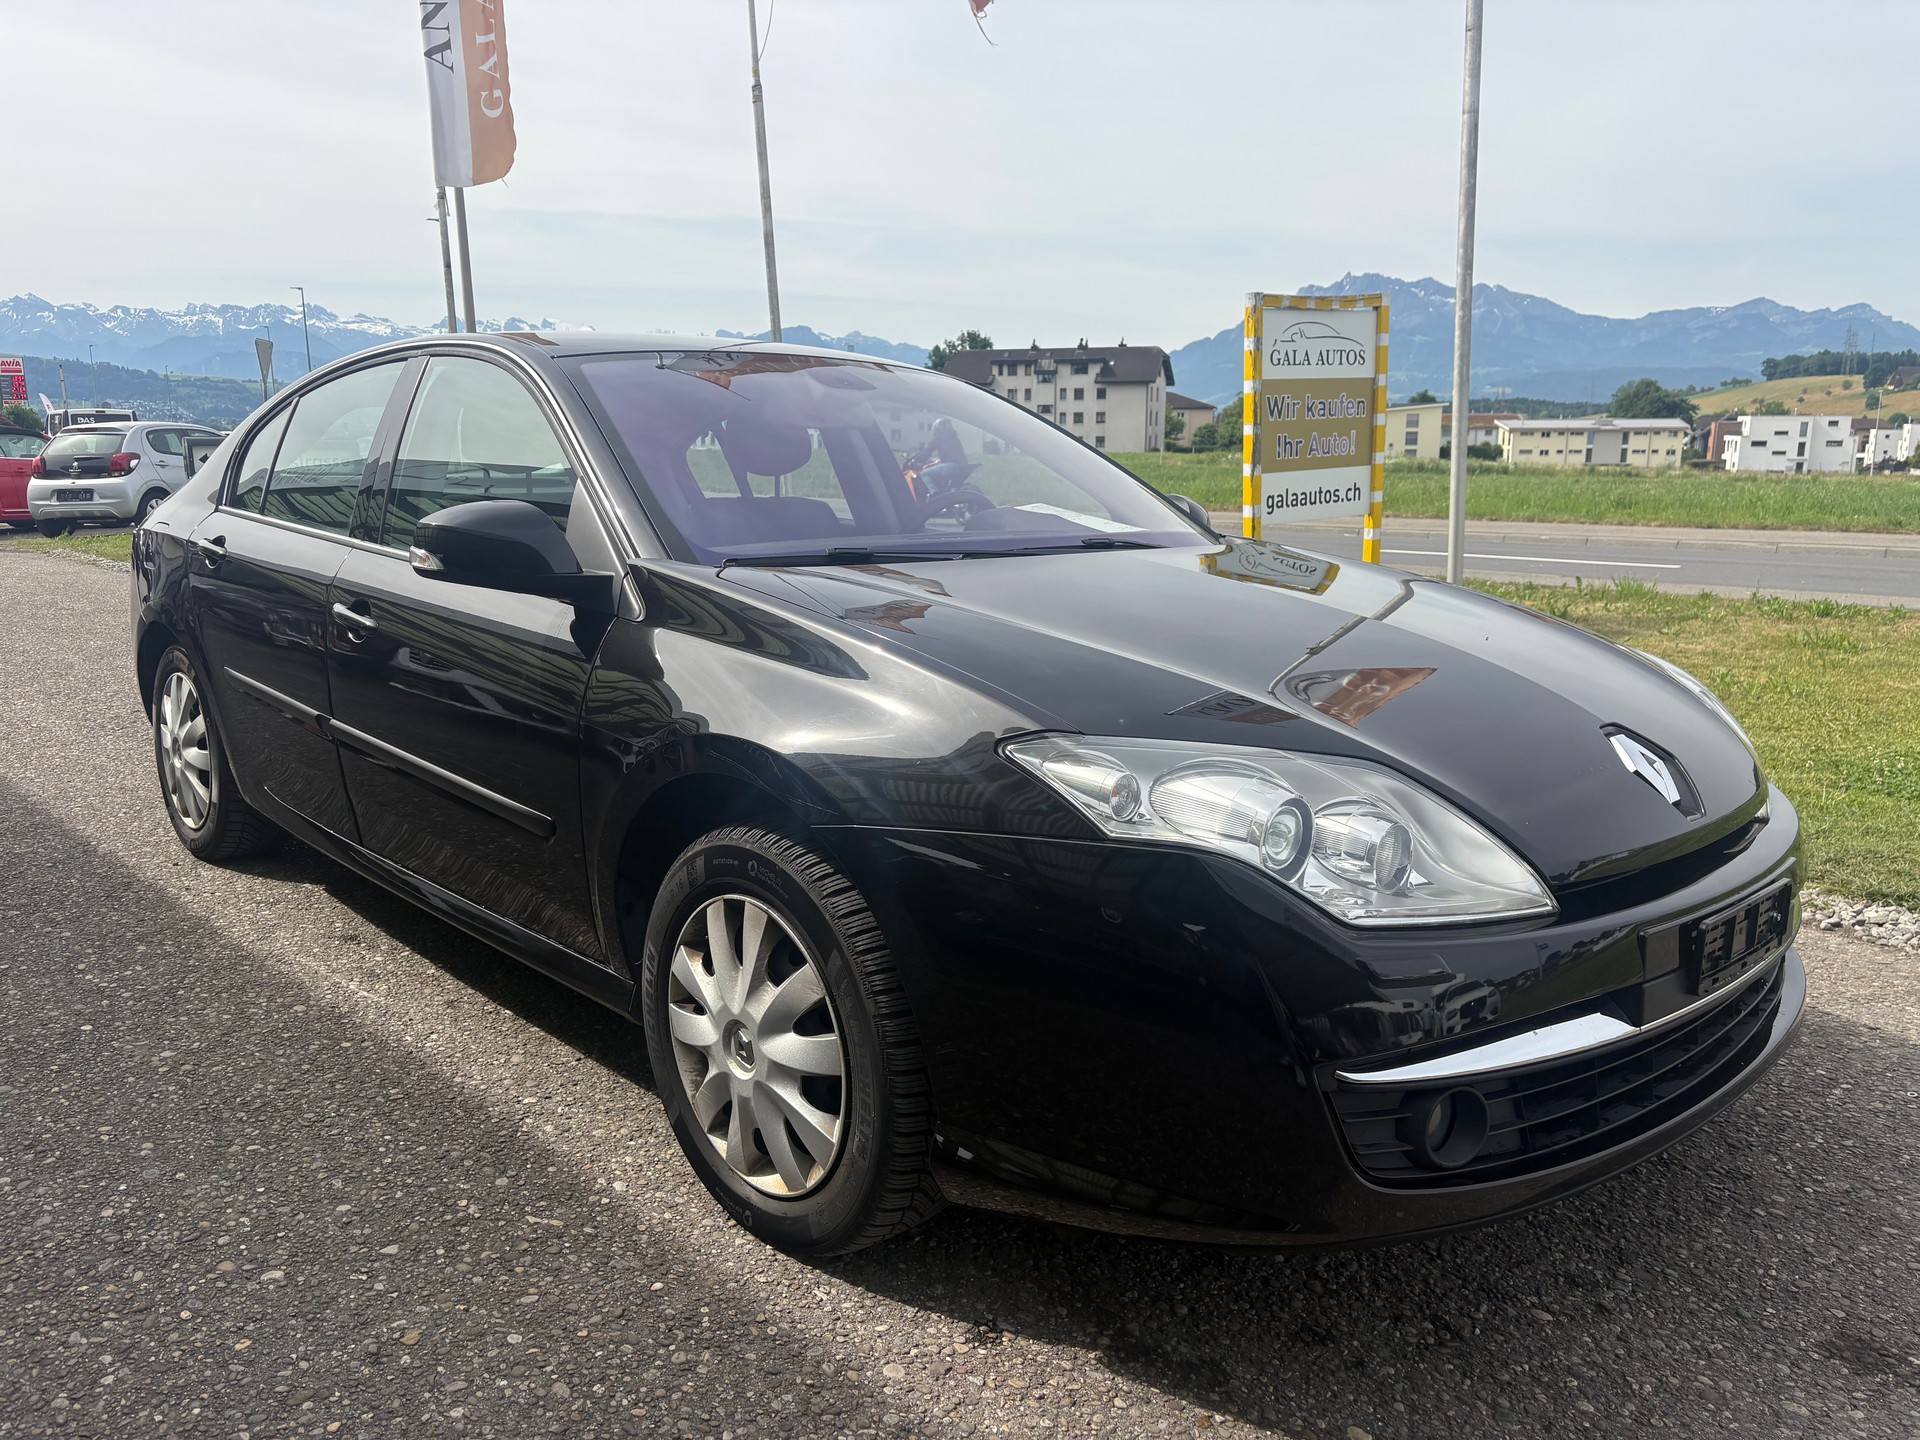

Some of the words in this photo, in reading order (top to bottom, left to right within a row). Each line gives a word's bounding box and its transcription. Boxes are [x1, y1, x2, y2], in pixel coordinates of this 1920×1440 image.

[1270, 348, 1312, 366] GALA
[1315, 349, 1366, 366] AUTOS
[1266, 395, 1301, 421] Wir
[1305, 393, 1367, 420] kaufen
[1276, 434, 1304, 460] Ihr
[1307, 430, 1357, 458] Auto!
[1266, 482, 1362, 515] galaautos.ch
